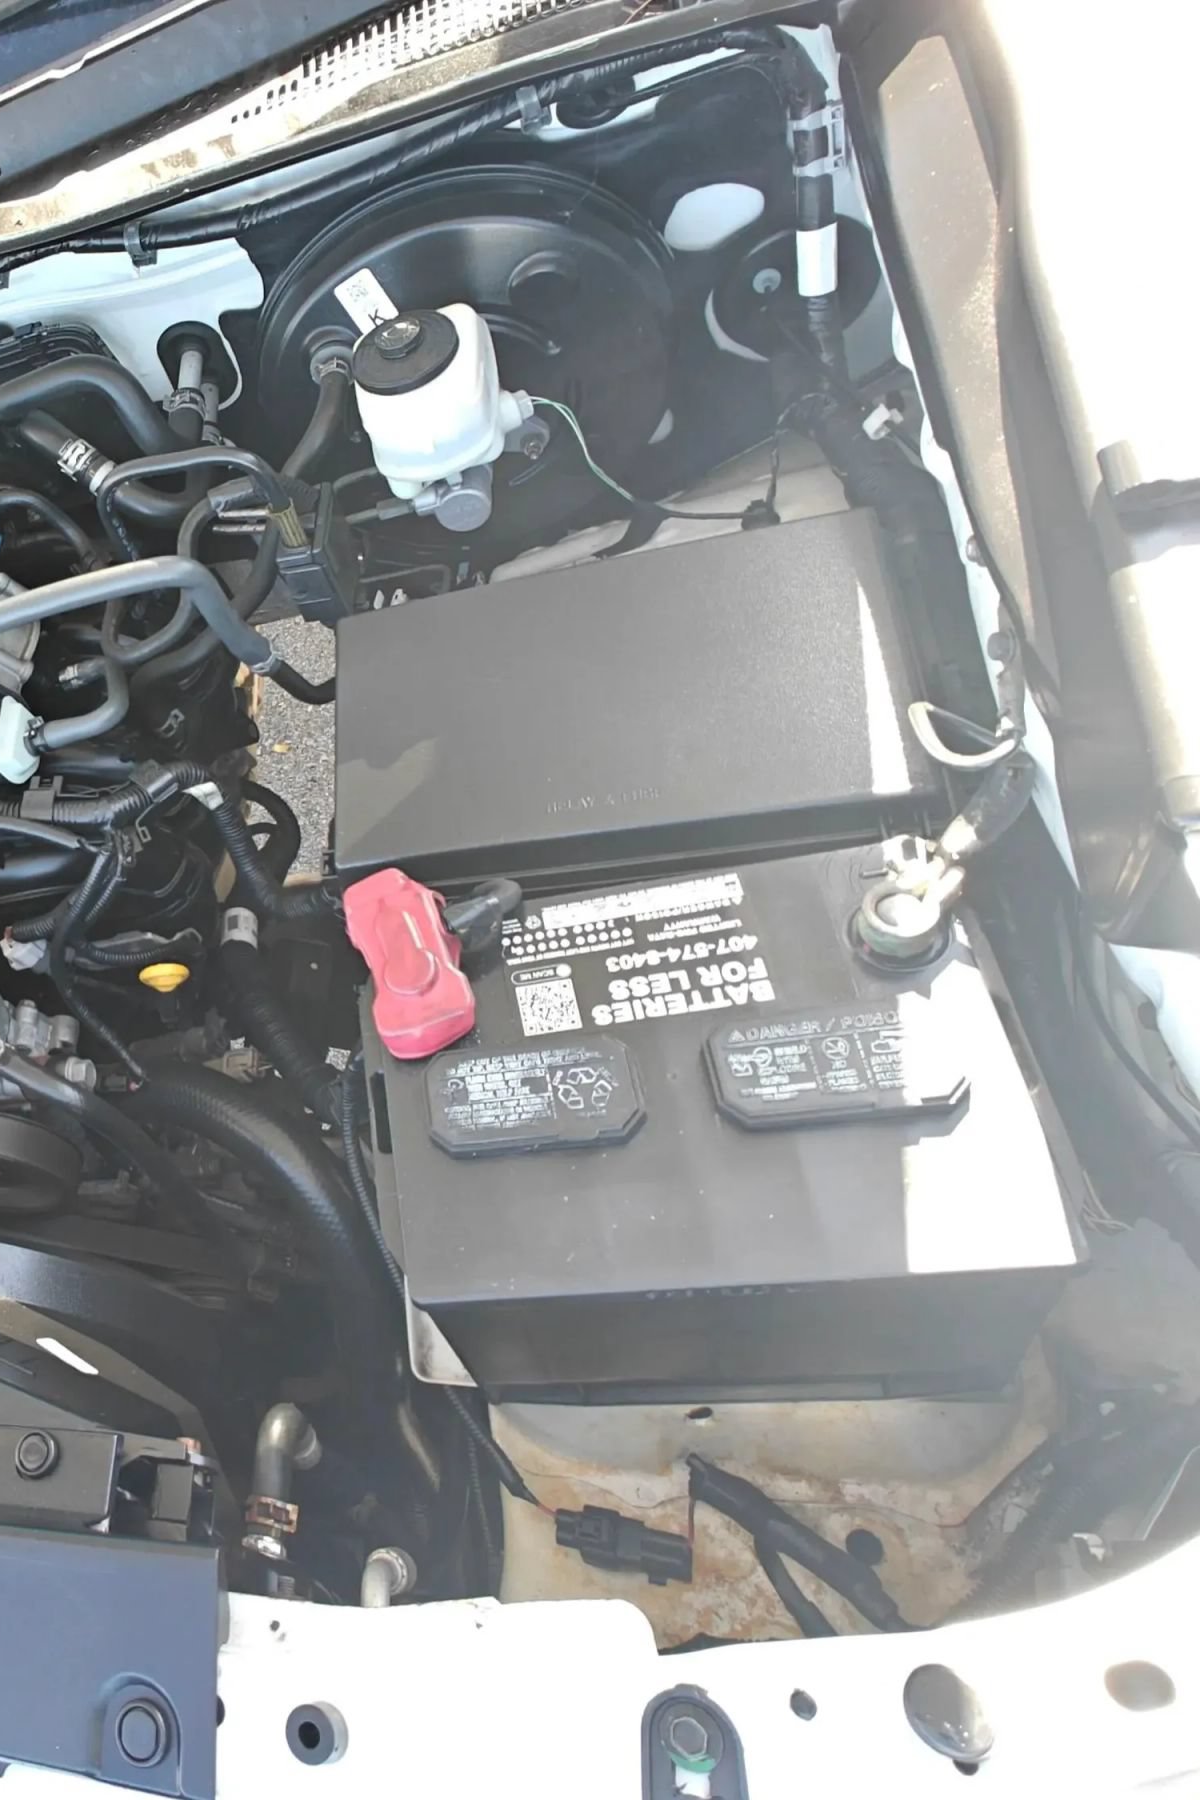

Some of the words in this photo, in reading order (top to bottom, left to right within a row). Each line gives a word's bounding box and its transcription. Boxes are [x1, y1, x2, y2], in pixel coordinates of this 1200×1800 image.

[367, 308, 386, 327] K
[605, 934, 758, 973] 407-574-8403
[608, 969, 692, 1001] LESS
[696, 957, 769, 987] FOR
[591, 979, 776, 1027] BATTERIES
[745, 1020, 822, 1040] DANGER
[840, 1009, 901, 1030] POISO
